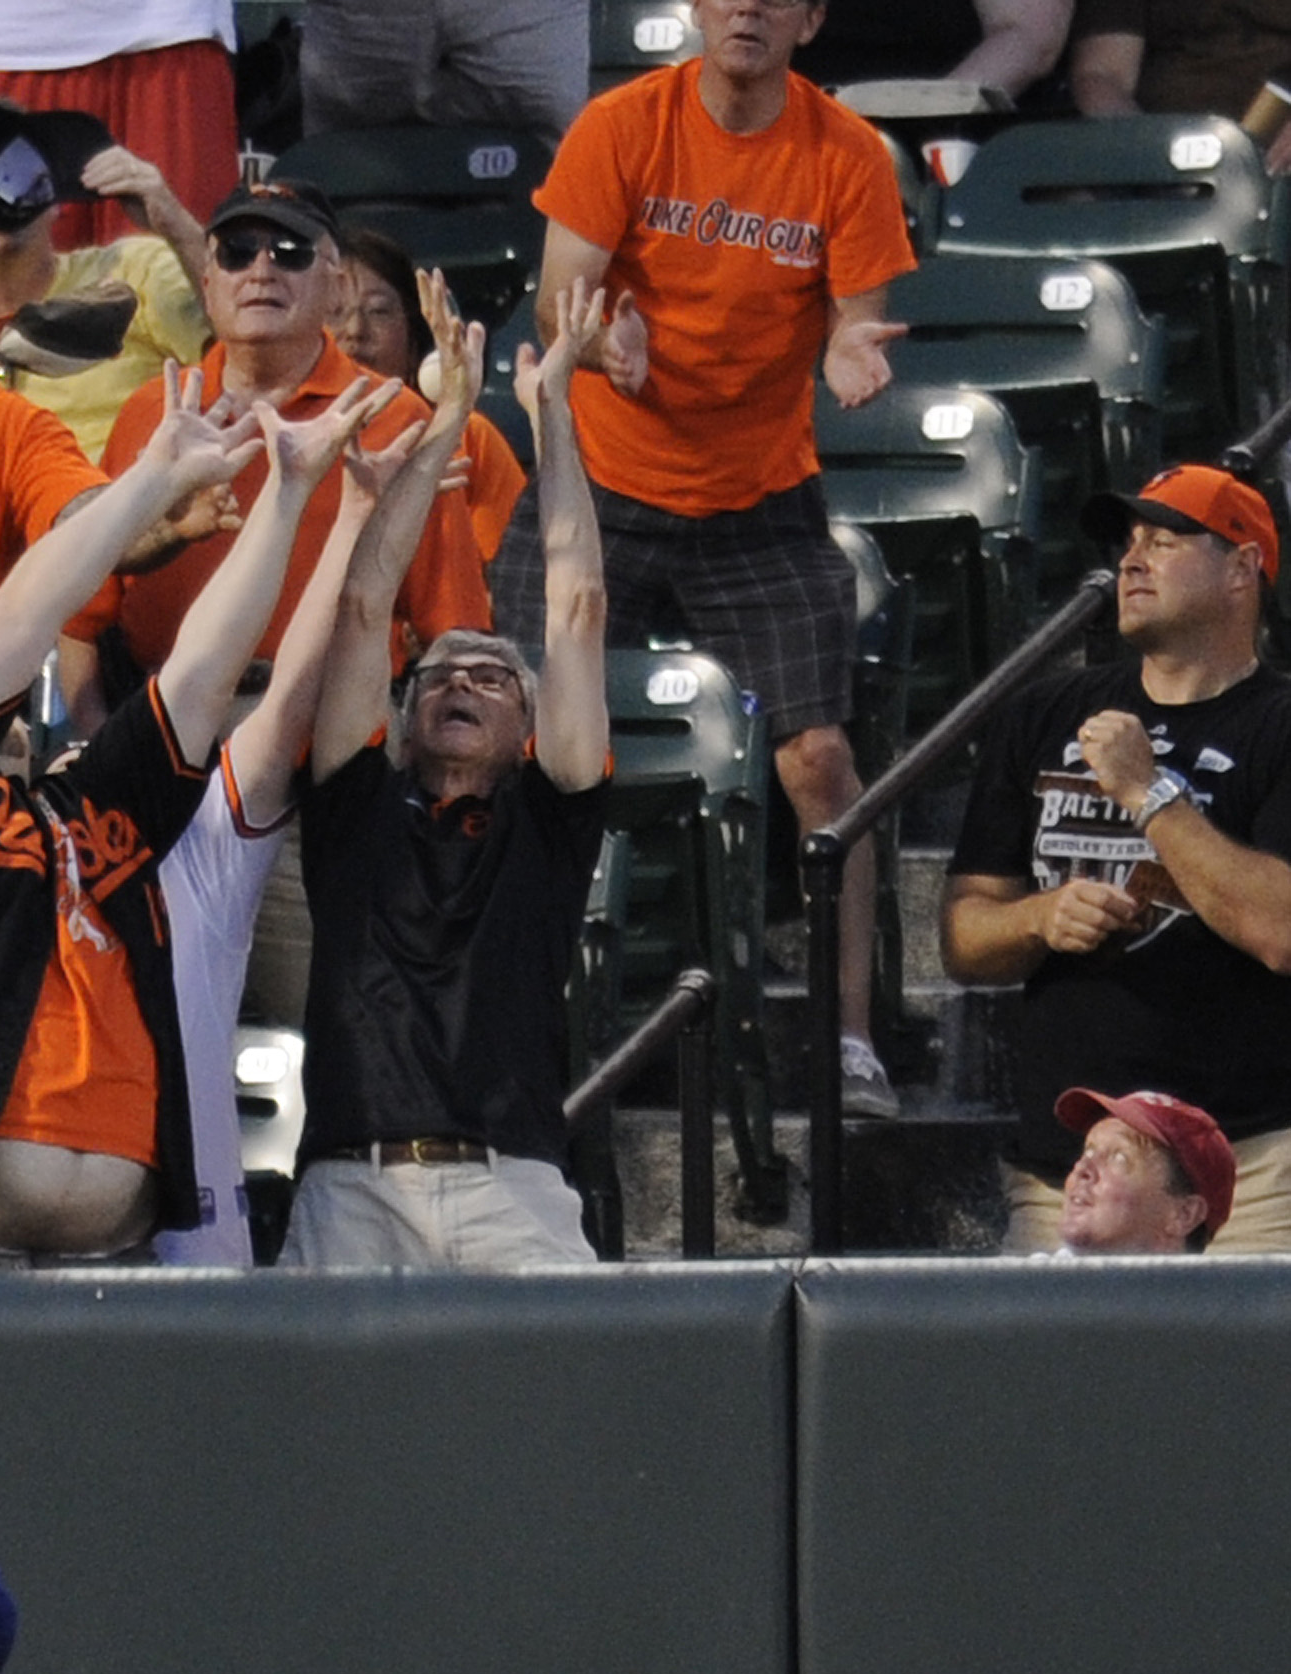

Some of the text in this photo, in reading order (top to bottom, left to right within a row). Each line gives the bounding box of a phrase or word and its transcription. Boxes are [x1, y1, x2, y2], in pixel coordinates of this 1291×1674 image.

[649, 24, 670, 46] 11
[481, 150, 508, 175] 10
[1184, 140, 1208, 164] 12
[697, 198, 764, 248] OUR
[1056, 281, 1079, 304] 12
[938, 411, 959, 434] 11
[662, 675, 688, 699] 10
